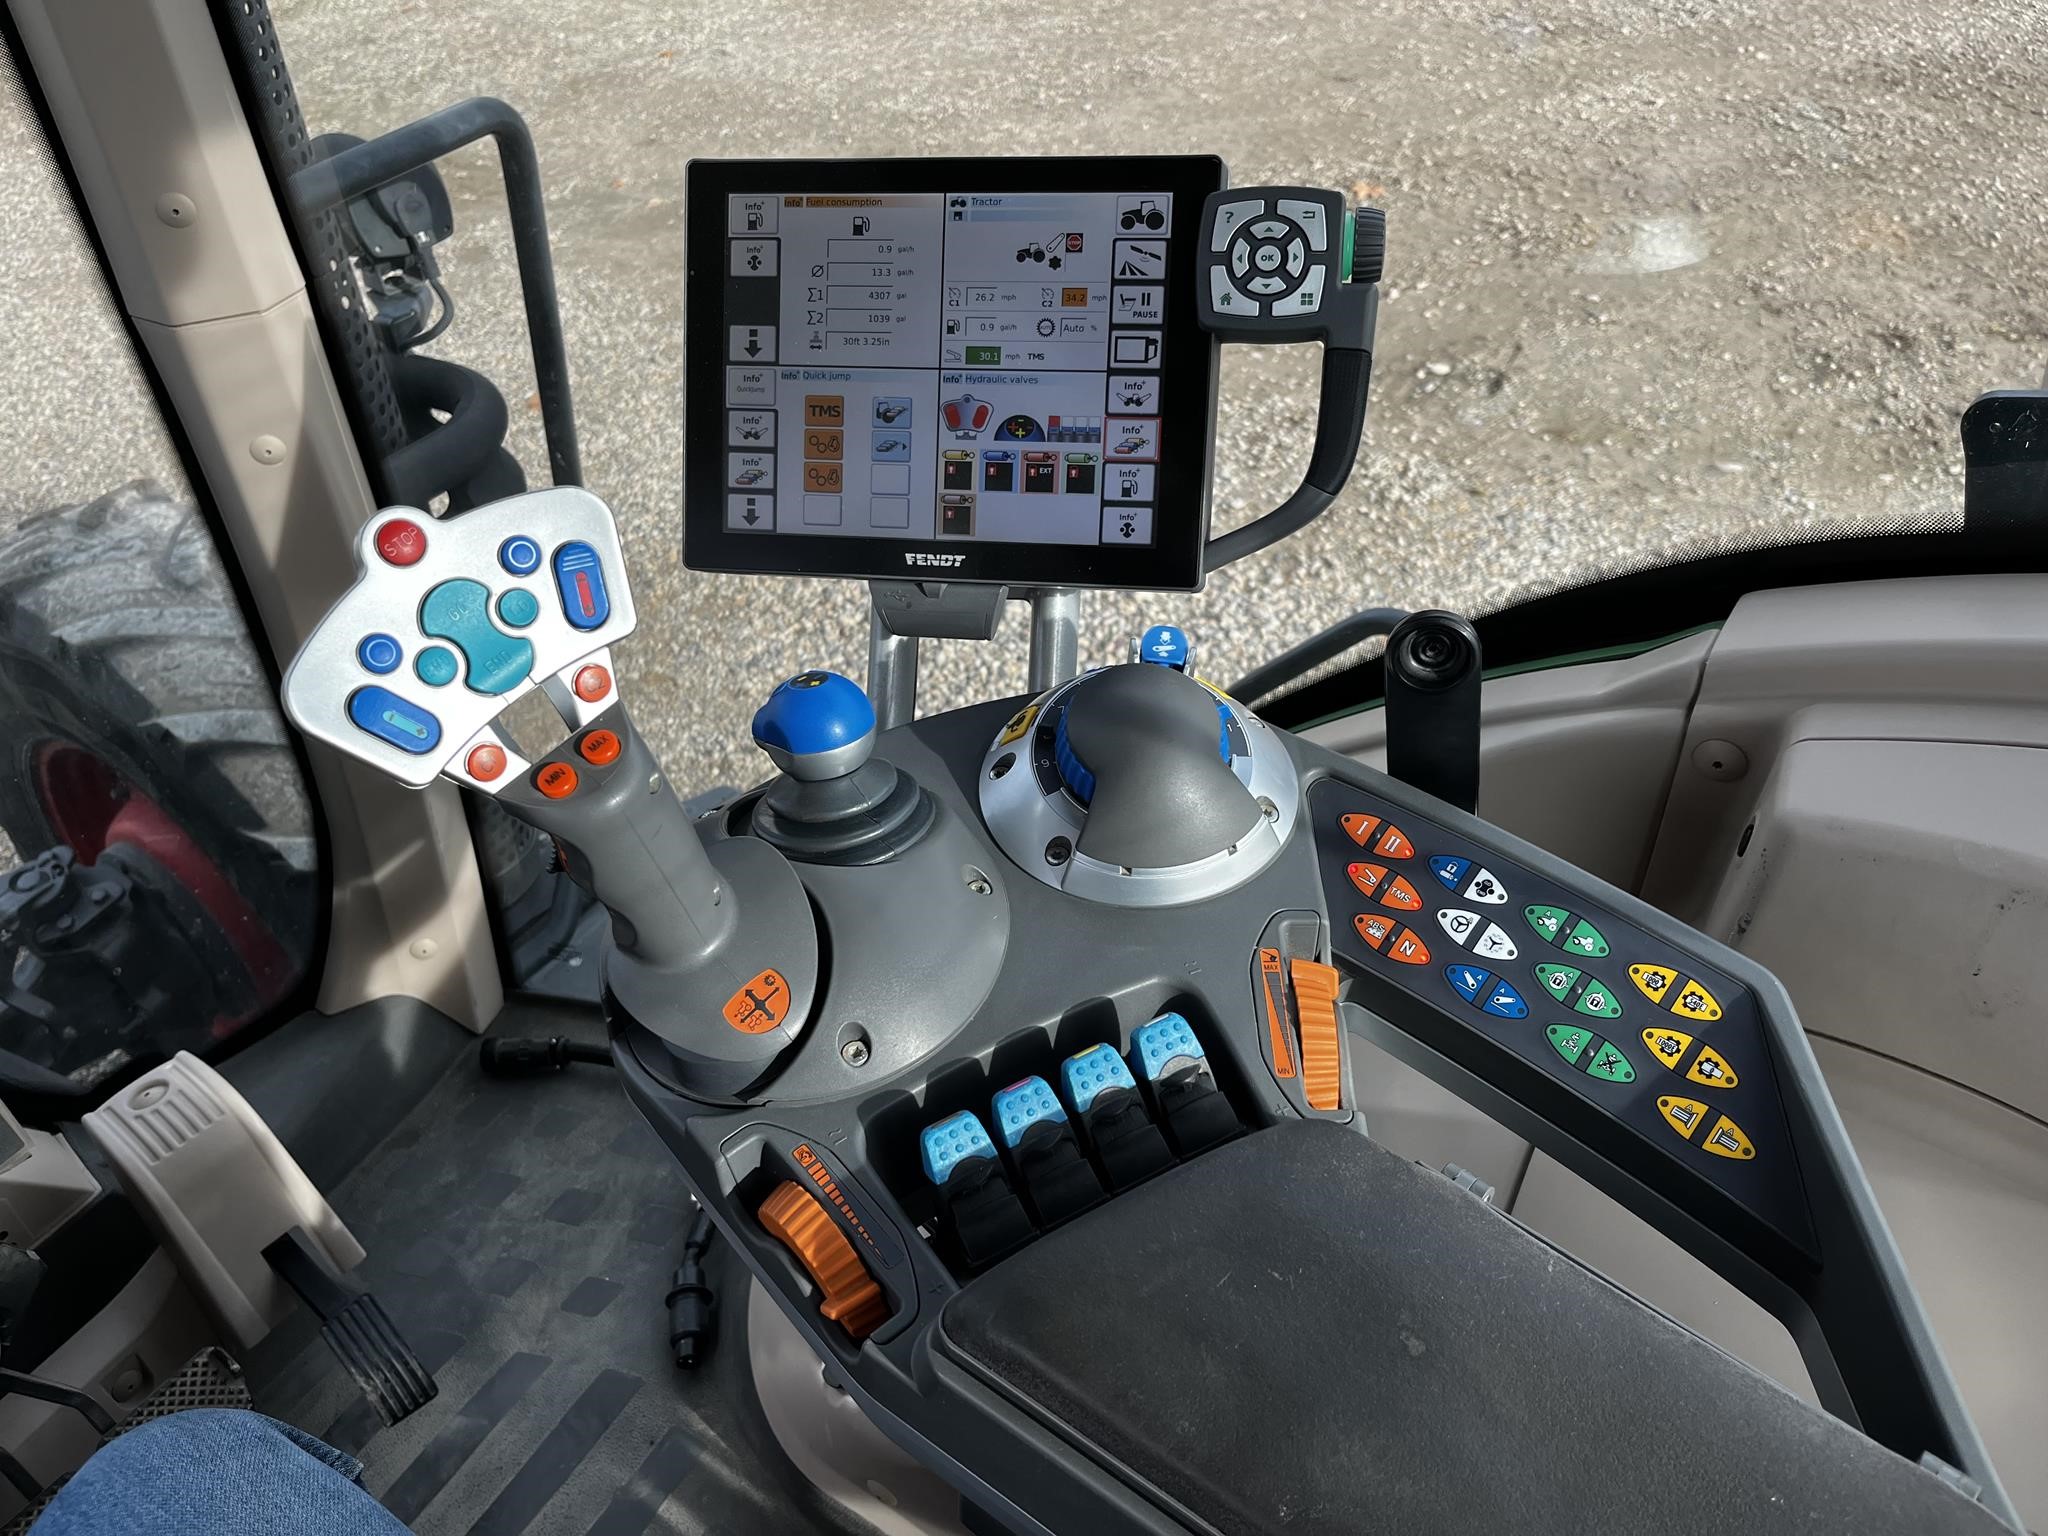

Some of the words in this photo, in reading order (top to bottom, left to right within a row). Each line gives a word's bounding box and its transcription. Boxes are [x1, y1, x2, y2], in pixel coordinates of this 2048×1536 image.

[826, 198, 883, 208] consumption
[971, 198, 1002, 206] Tractor
[878, 245, 892, 253] 0.9
[1261, 254, 1275, 262] OK
[872, 268, 891, 276] 13.3
[868, 291, 890, 300] 4307
[975, 293, 995, 301] 26.2
[1001, 294, 1017, 302] mph
[1091, 294, 1108, 302] mph
[1041, 300, 1053, 308] C2
[868, 314, 890, 323] 1039
[1133, 311, 1158, 319] PAUSE
[980, 323, 994, 331] 0.9
[1063, 324, 1085, 333] Auto
[842, 337, 861, 346] 30ft
[863, 337, 890, 346] 3.25in
[979, 352, 999, 361] 30.1
[1005, 353, 1021, 361] mph
[1028, 353, 1045, 361] TMS
[802, 371, 827, 380] Quick
[829, 372, 851, 382] jump
[965, 375, 1007, 385] Hydraulic
[1010, 376, 1039, 384] valves
[809, 405, 841, 418] TMS
[1039, 467, 1052, 475] EXT
[384, 527, 417, 557] STOP
[905, 553, 966, 567] FENDT
[587, 735, 610, 753] MAX
[544, 768, 566, 786] MIN
[1389, 886, 1411, 904] TMS
[1367, 919, 1386, 932] ABS
[1399, 939, 1417, 957] N
[1276, 1067, 1290, 1075] MIN
